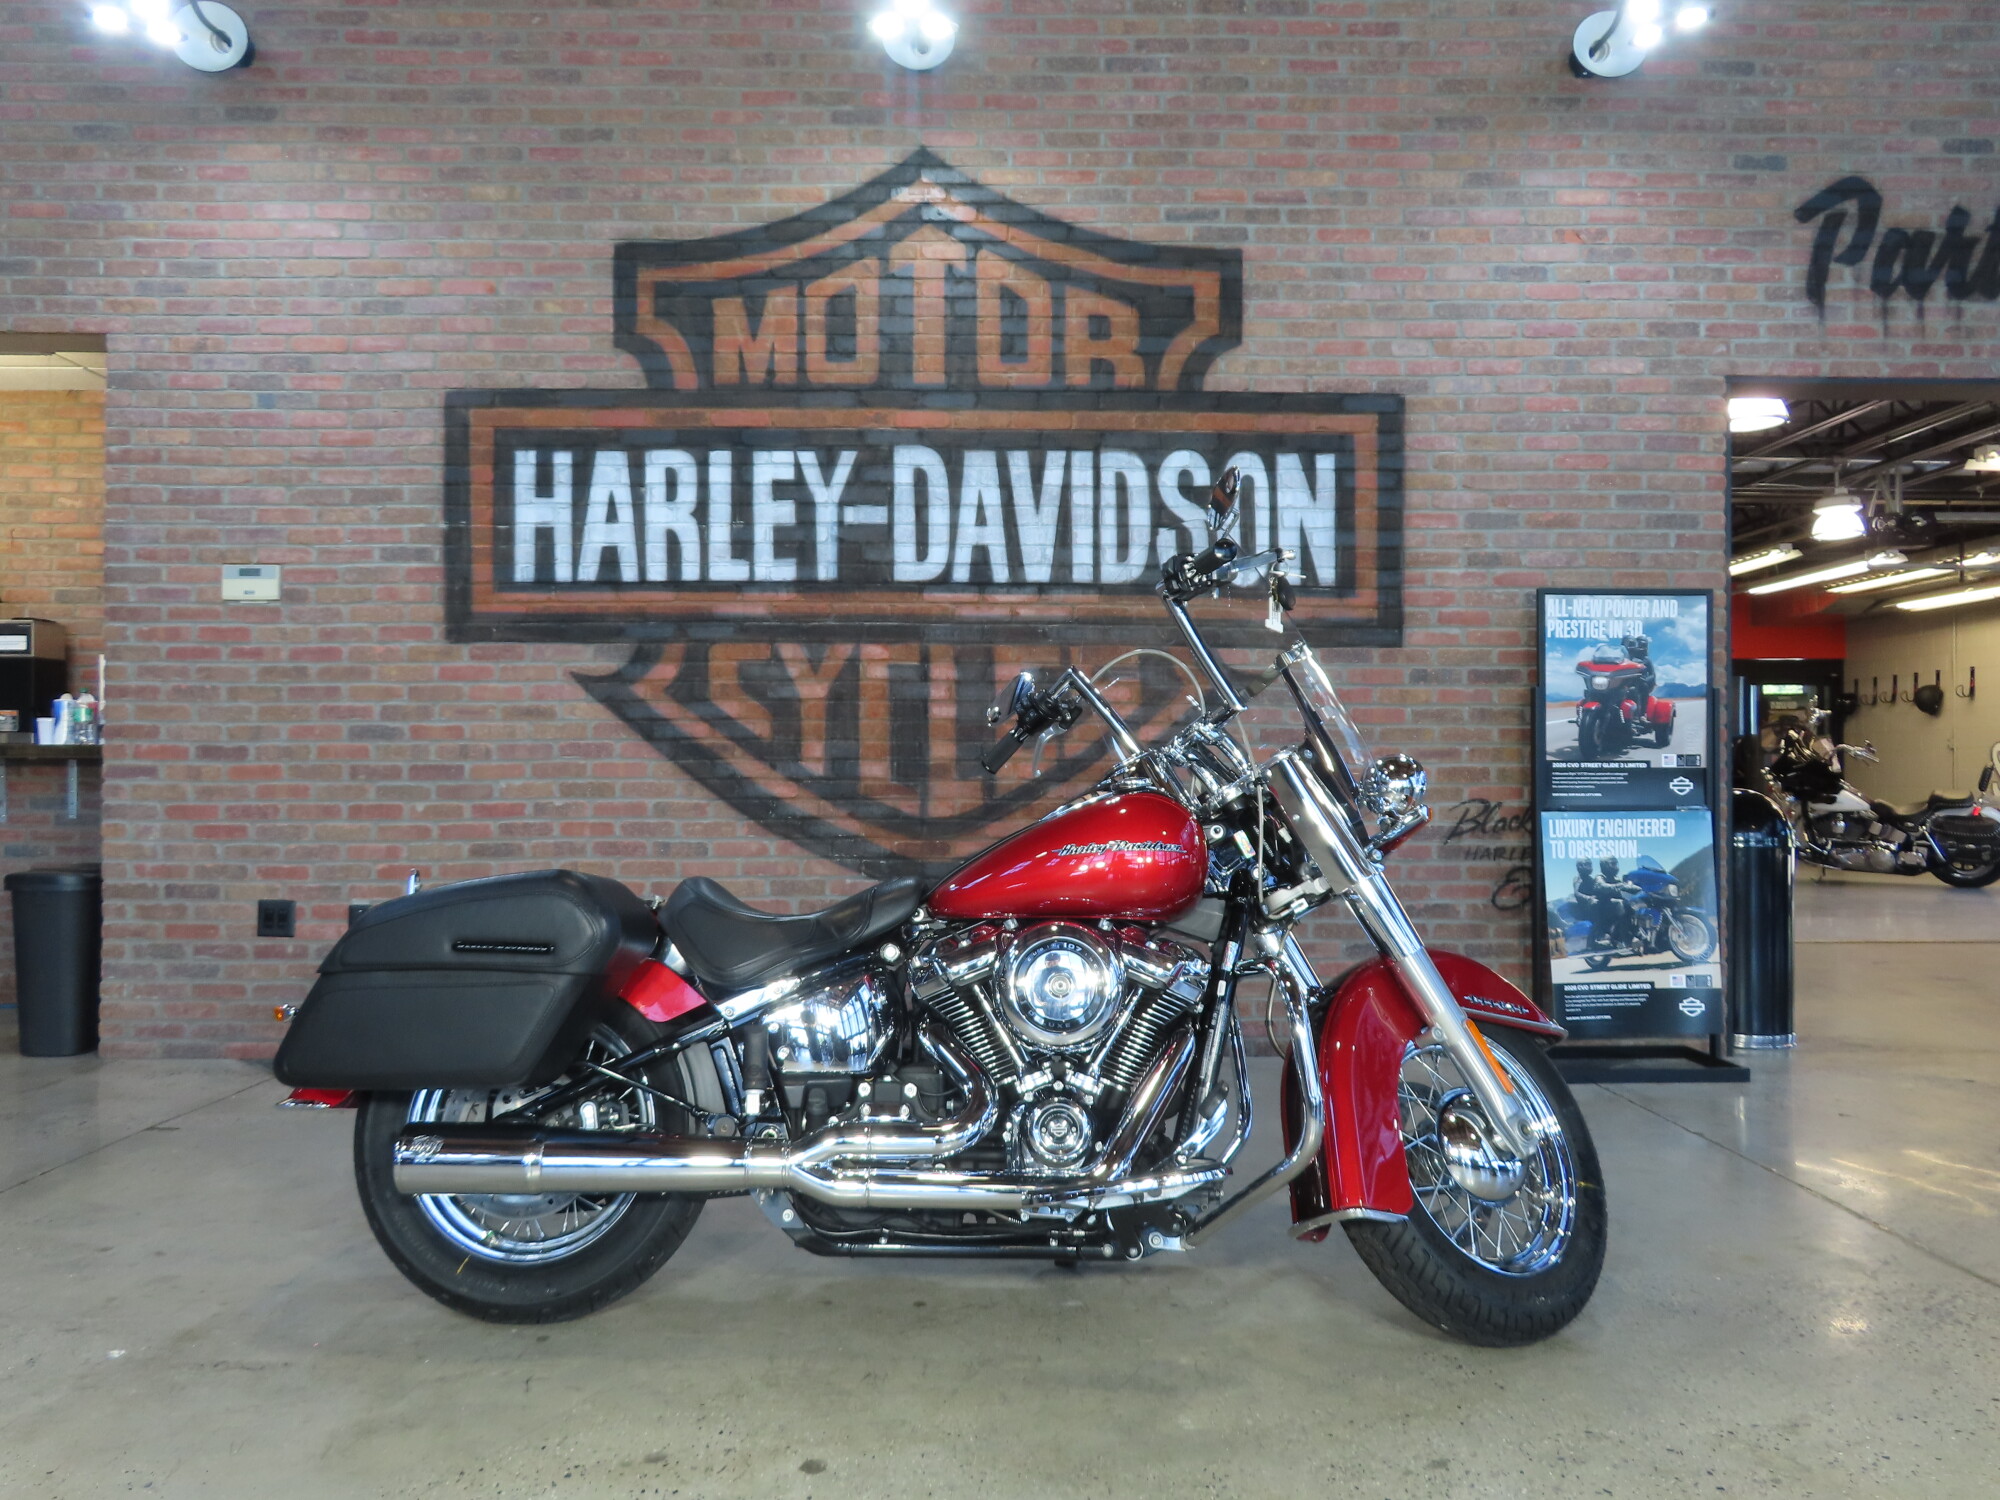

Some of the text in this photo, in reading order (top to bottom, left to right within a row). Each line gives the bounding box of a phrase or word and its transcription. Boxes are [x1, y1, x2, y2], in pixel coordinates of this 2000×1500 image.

[712, 226, 1146, 388] MOTOR
[513, 446, 1336, 585] HARLEY-DAVIDSON
[1547, 599, 1678, 618] ALL-NEW POWER AND
[1547, 619, 1607, 639] PRESTIGE
[1609, 620, 1623, 639] IN
[1548, 818, 1676, 837] LUXURY ENGINEERED
[1550, 840, 1566, 859] TO
[1062, 942, 1083, 953] 107
